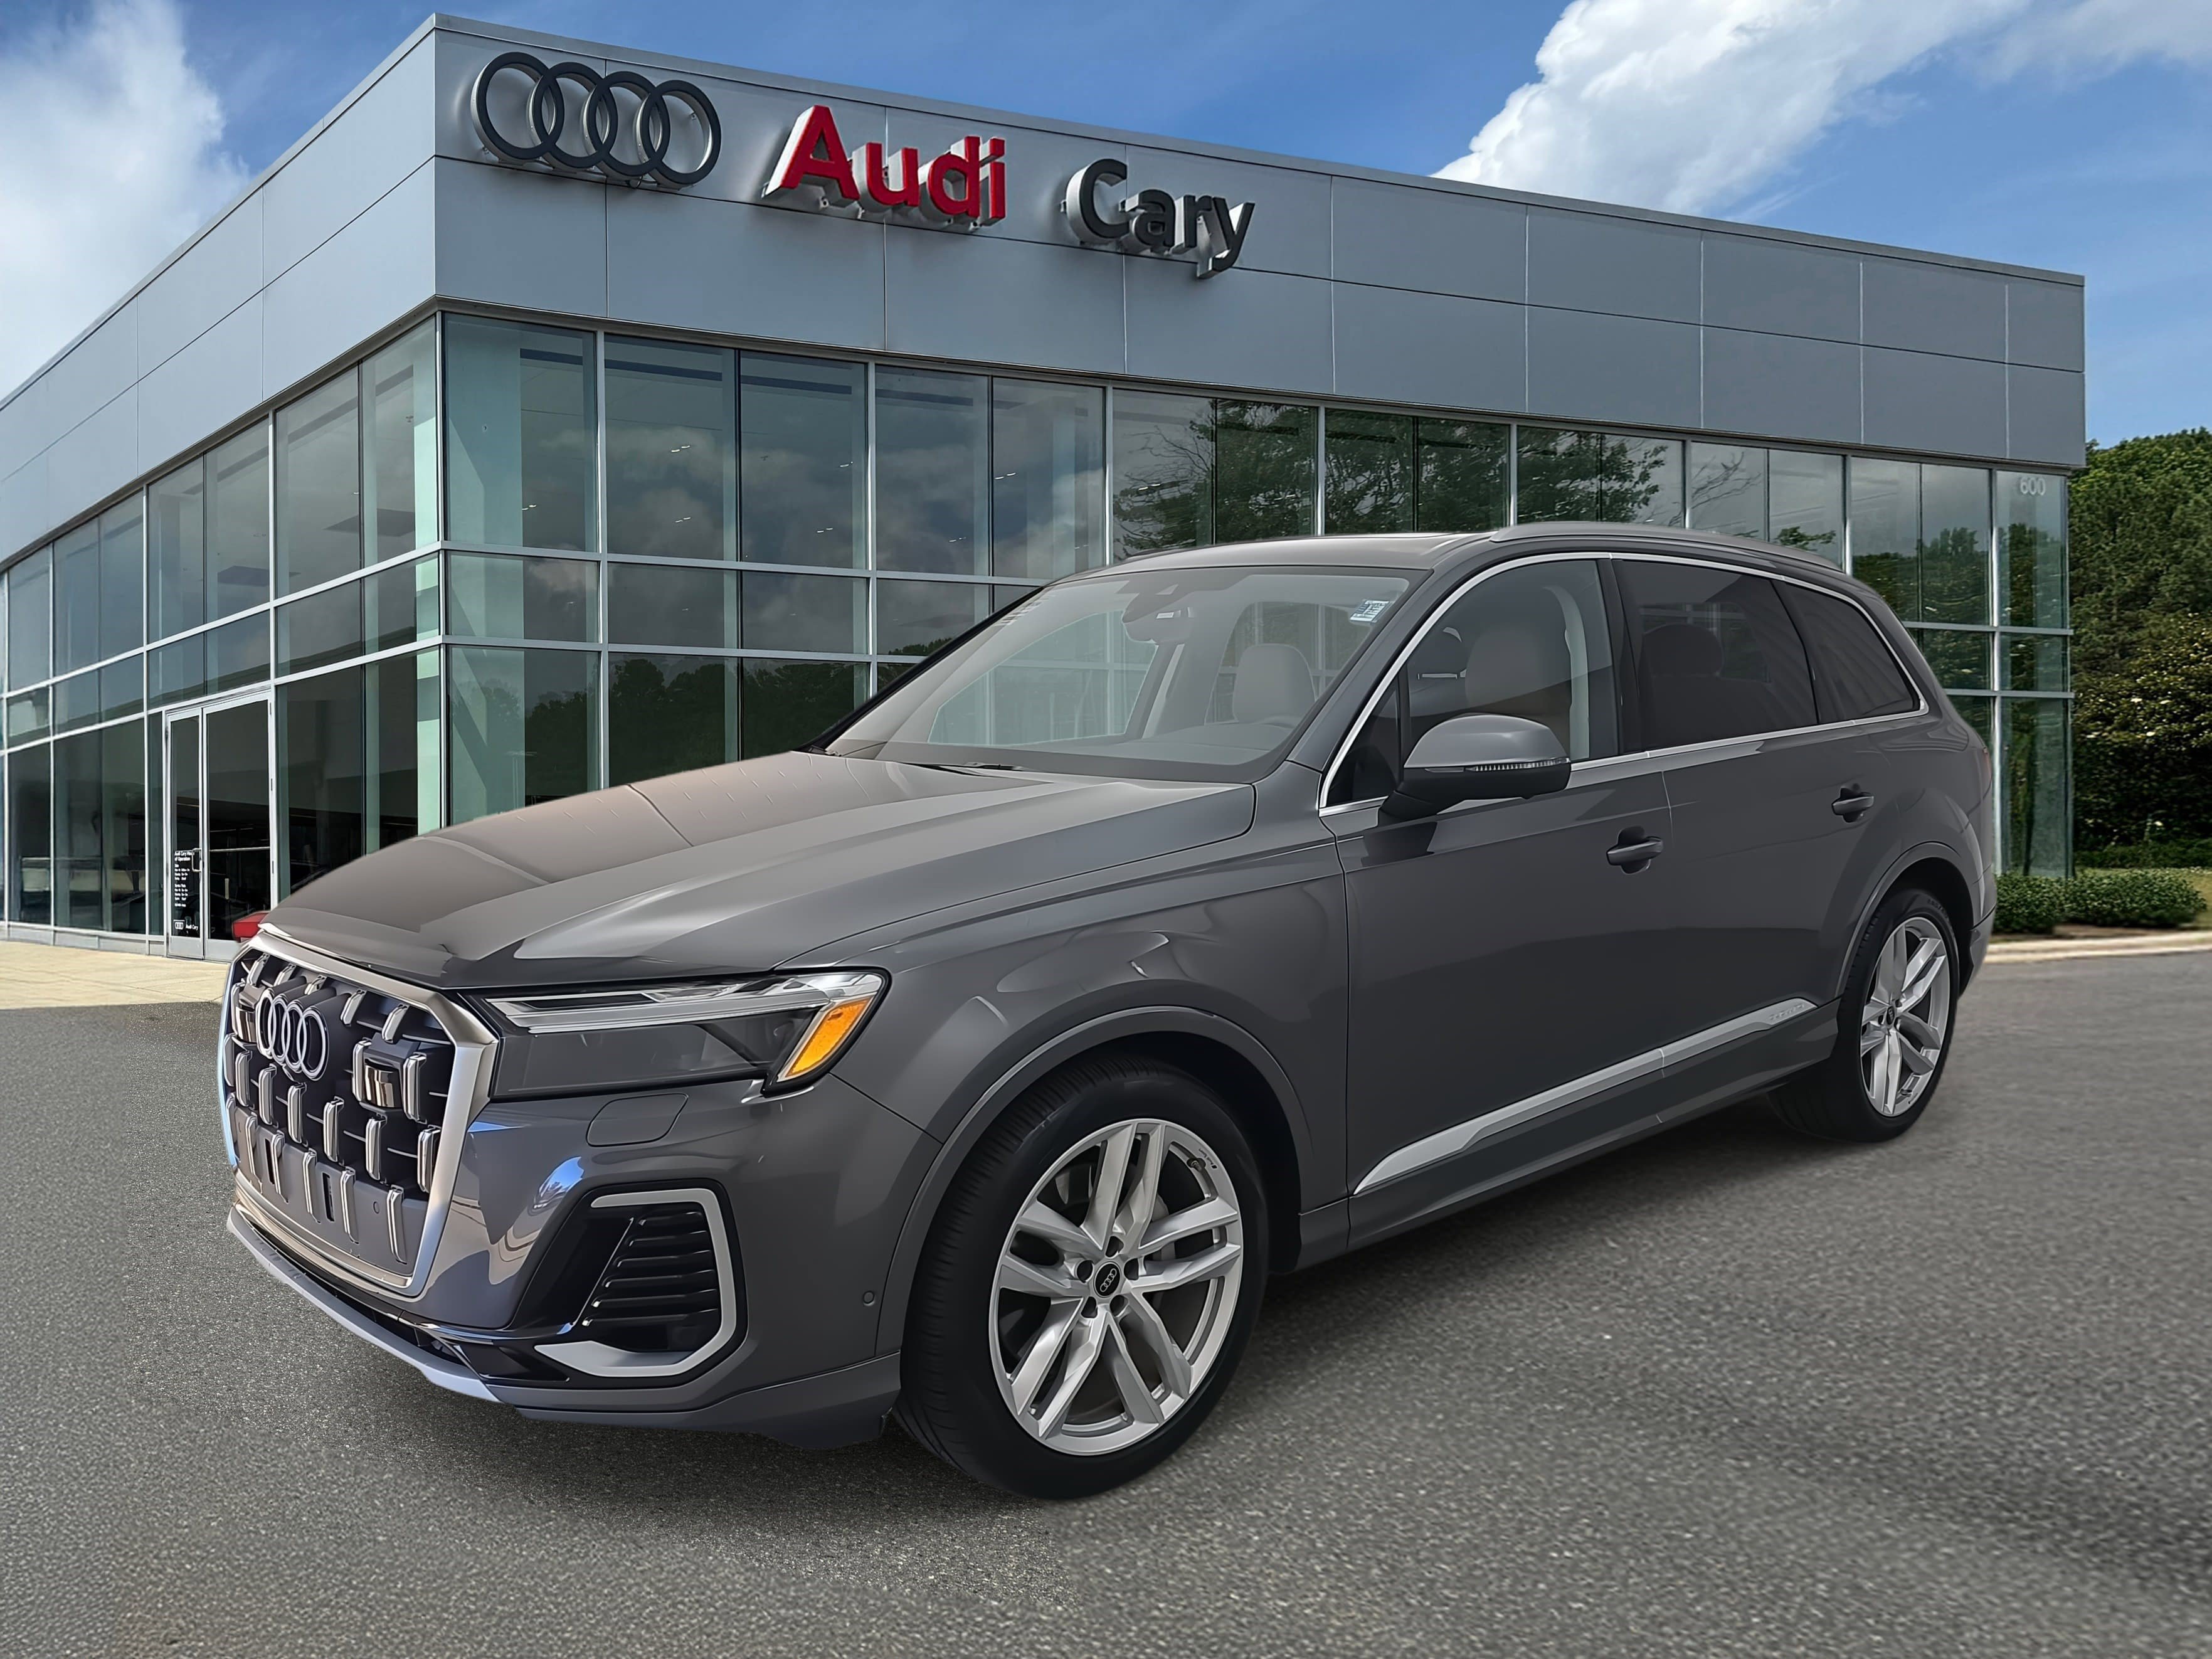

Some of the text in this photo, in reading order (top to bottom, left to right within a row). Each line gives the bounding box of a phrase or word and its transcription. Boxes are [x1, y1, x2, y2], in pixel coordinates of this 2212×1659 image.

[774, 104, 1255, 273] Audi Cary
[2019, 476, 2046, 496] 600
